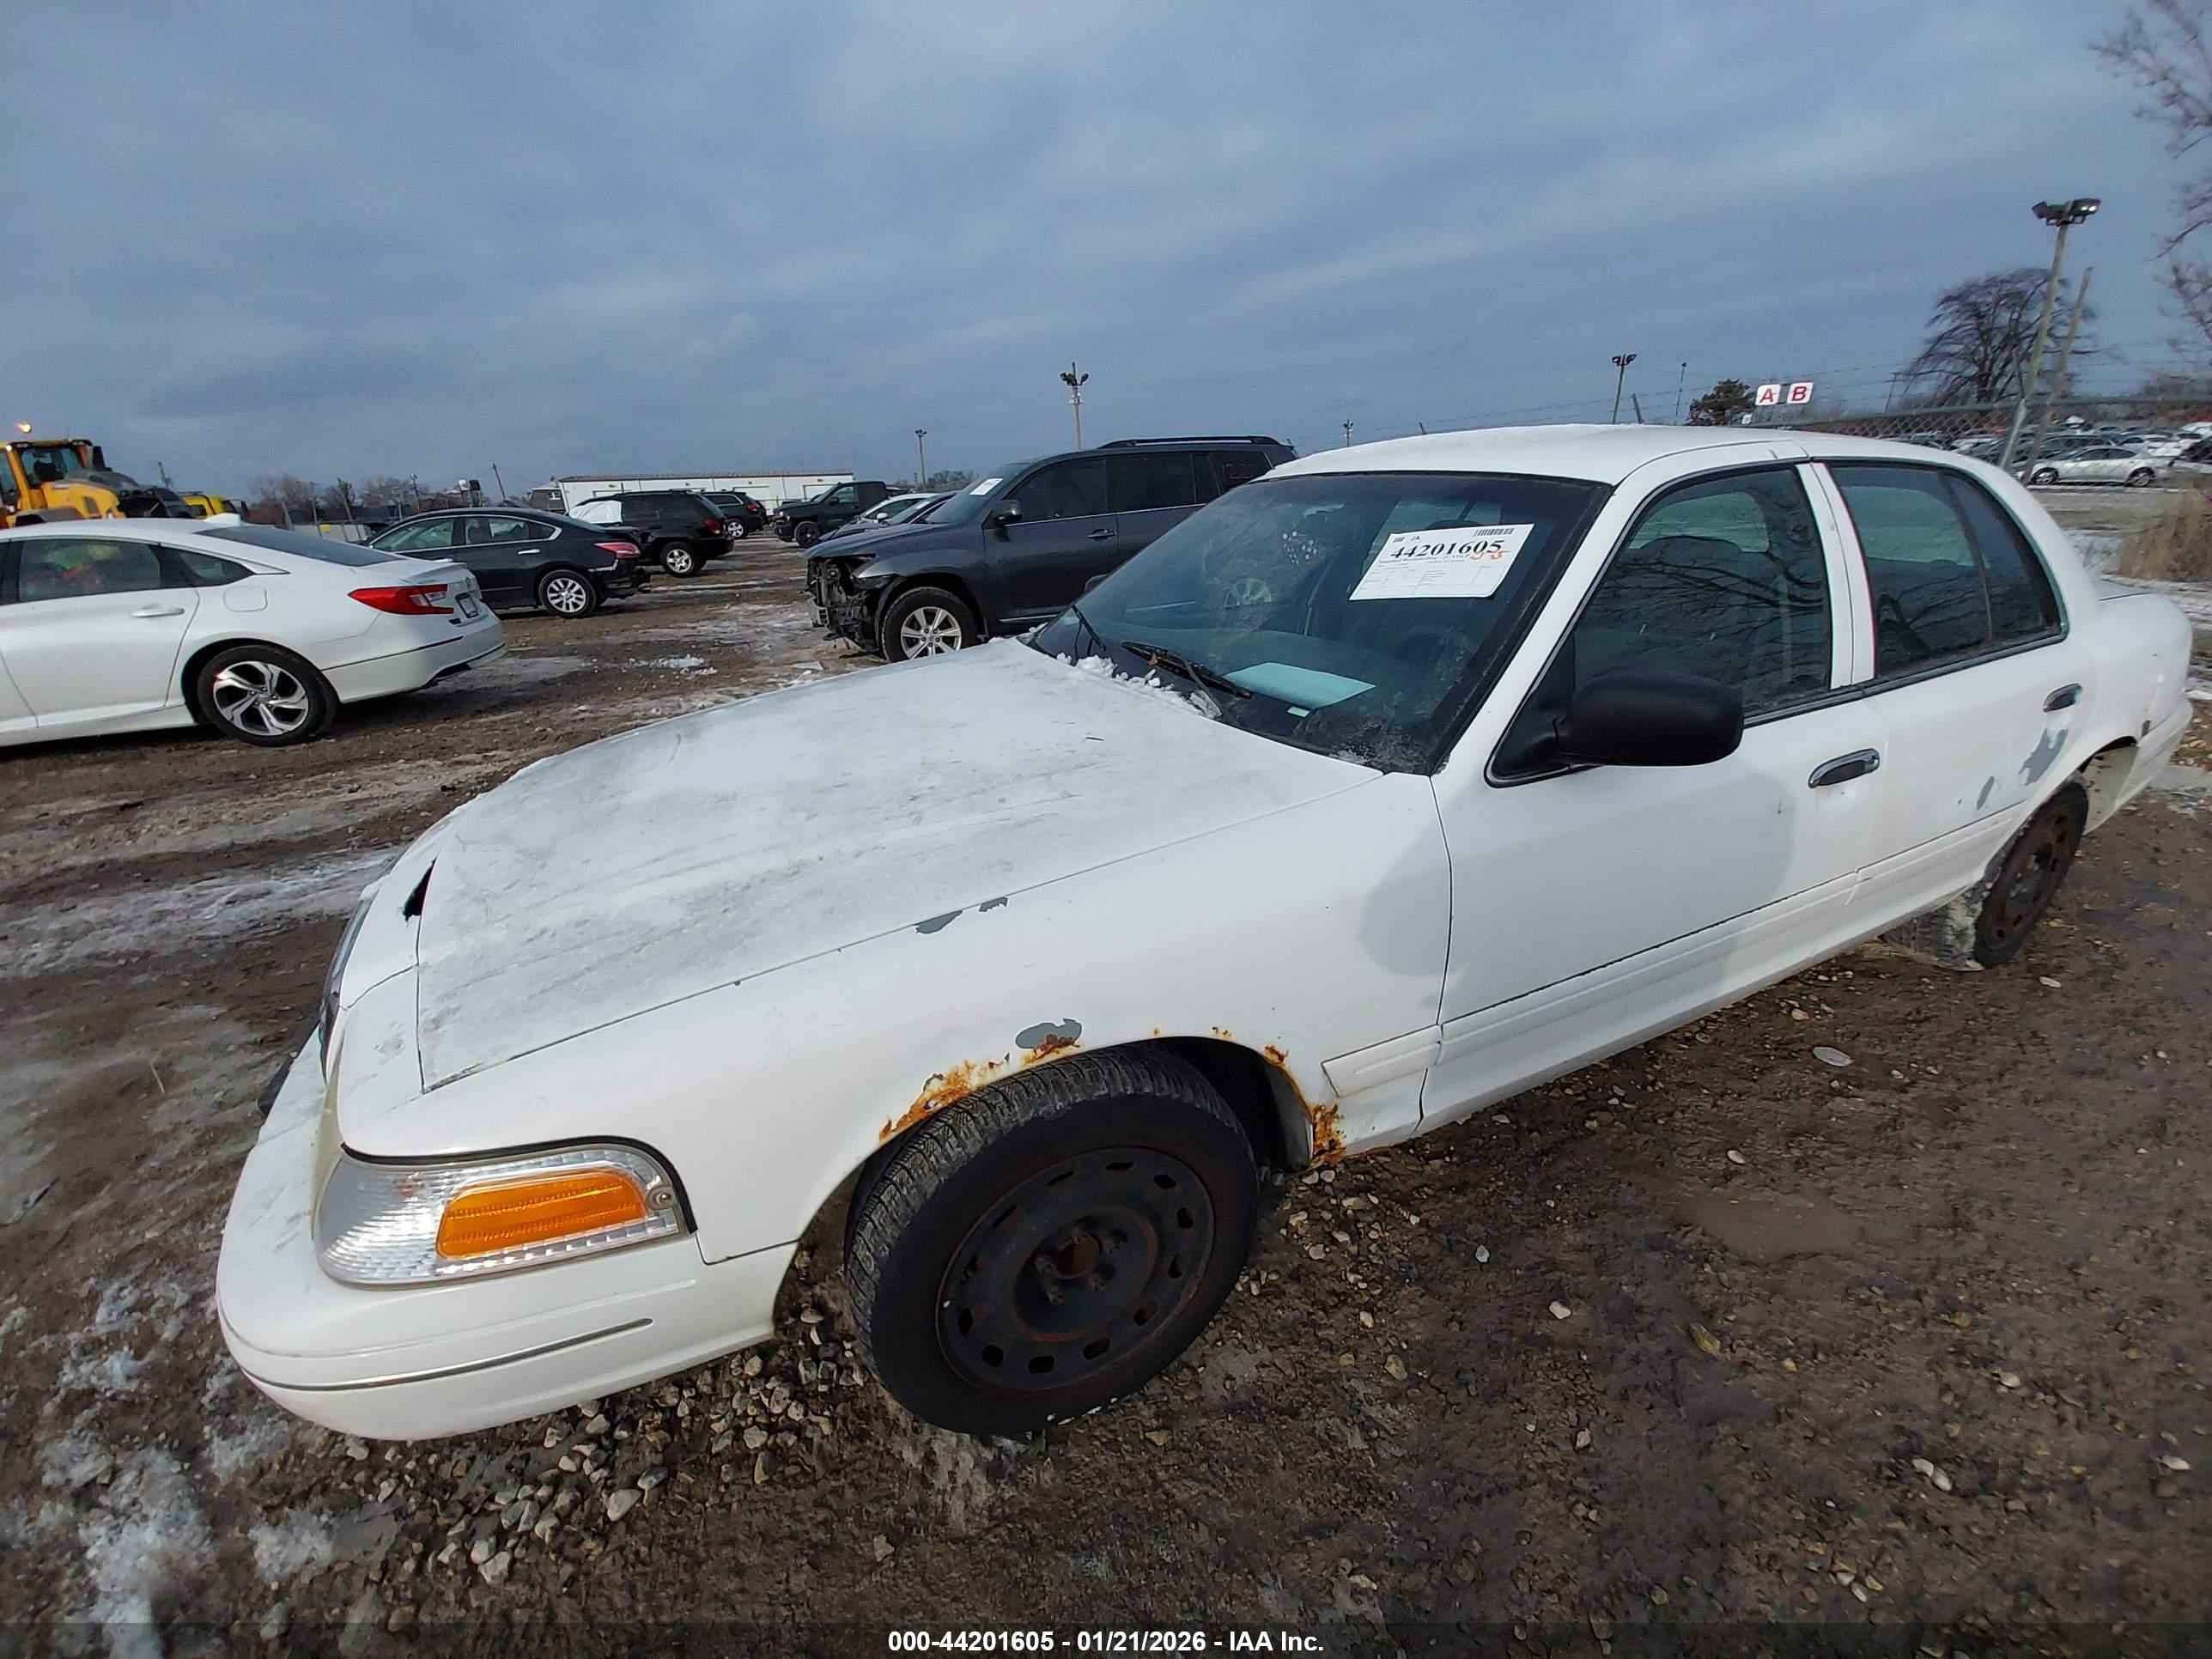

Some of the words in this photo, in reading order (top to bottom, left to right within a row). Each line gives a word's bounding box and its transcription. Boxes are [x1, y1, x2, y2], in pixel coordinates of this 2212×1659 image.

[1759, 388, 1774, 403] A
[1791, 386, 1808, 402] B
[1390, 539, 1505, 559] 44201605
